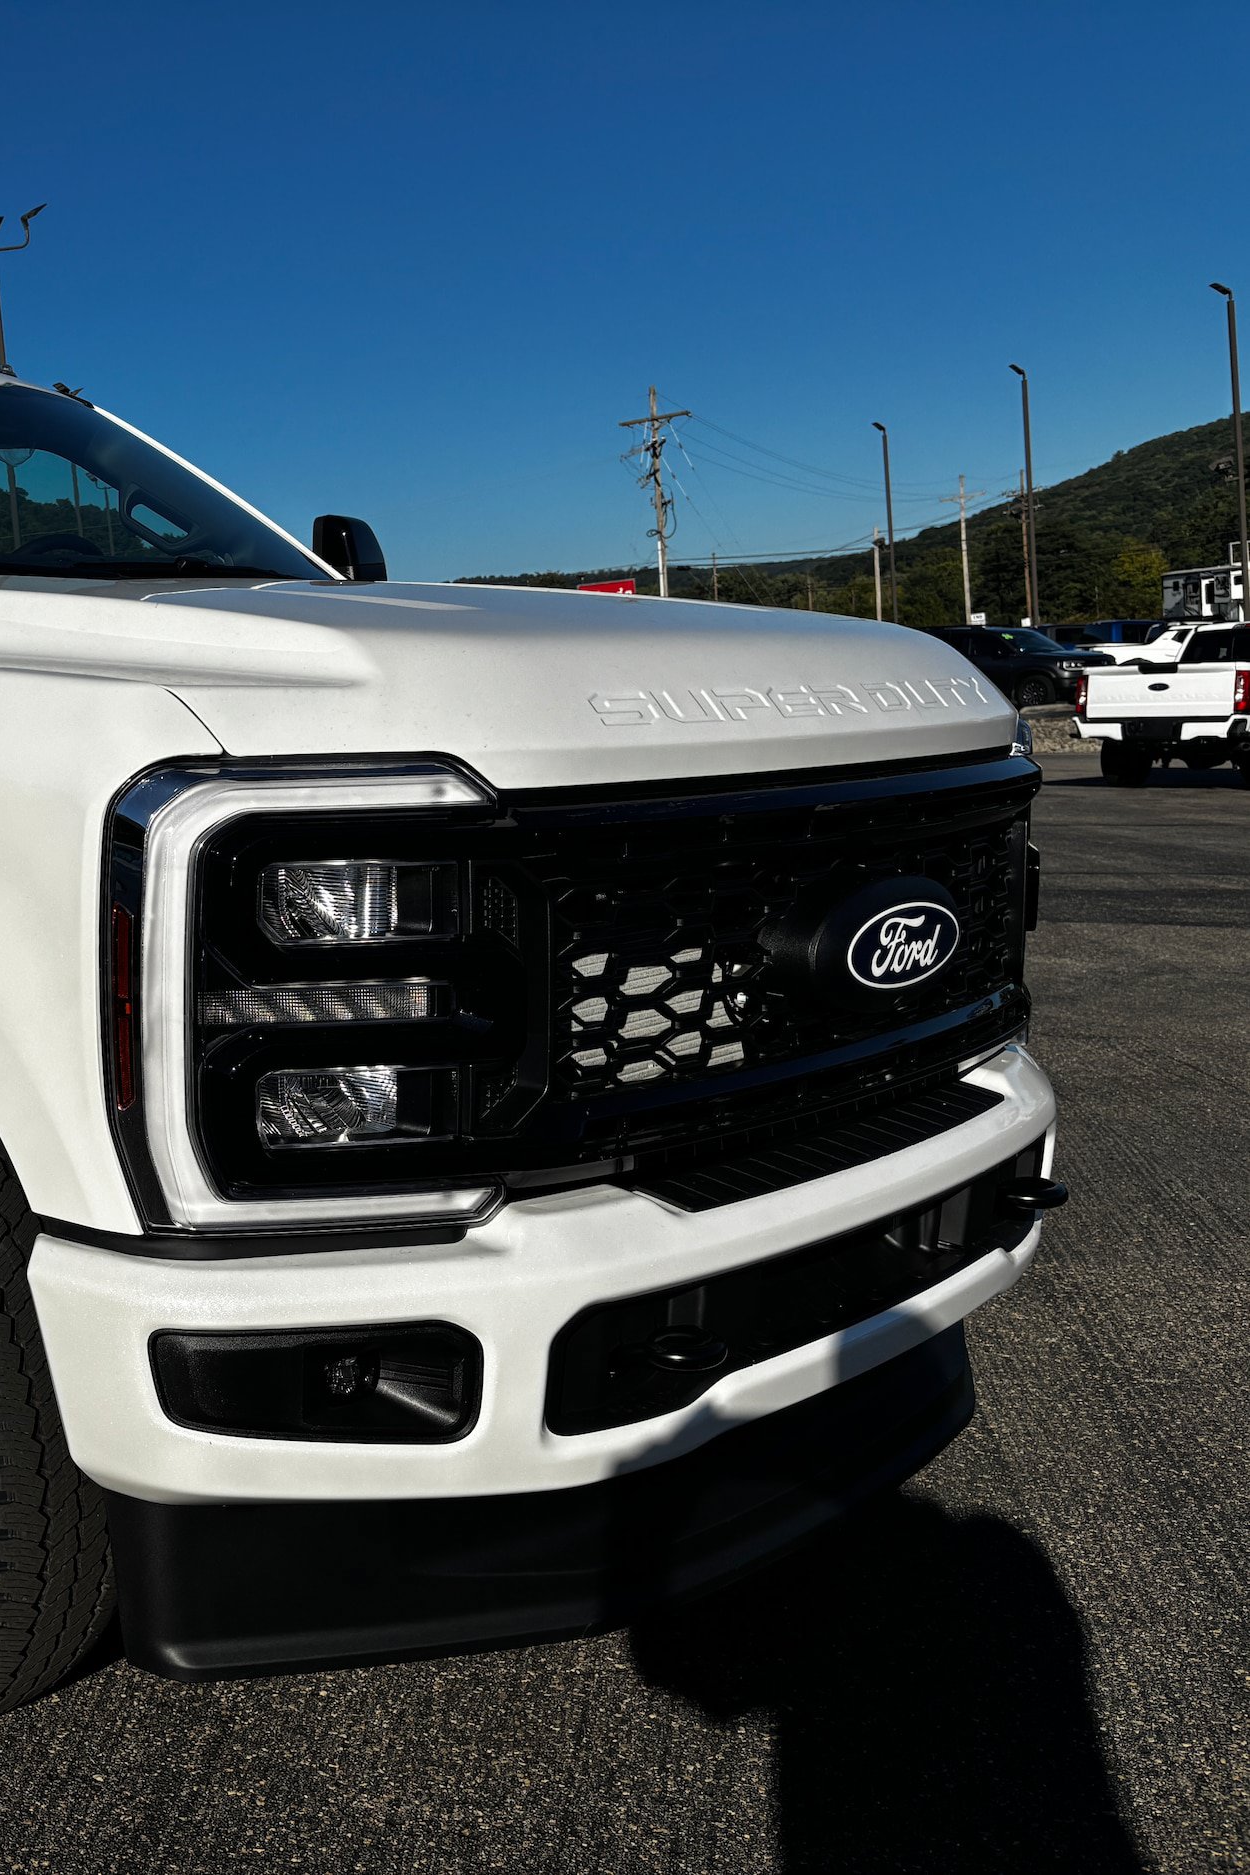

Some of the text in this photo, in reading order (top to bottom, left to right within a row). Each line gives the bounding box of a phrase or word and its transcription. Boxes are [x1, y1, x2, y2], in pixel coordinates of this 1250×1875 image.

[588, 676, 989, 727] SUPER DUTY
[871, 914, 942, 979] Ford
